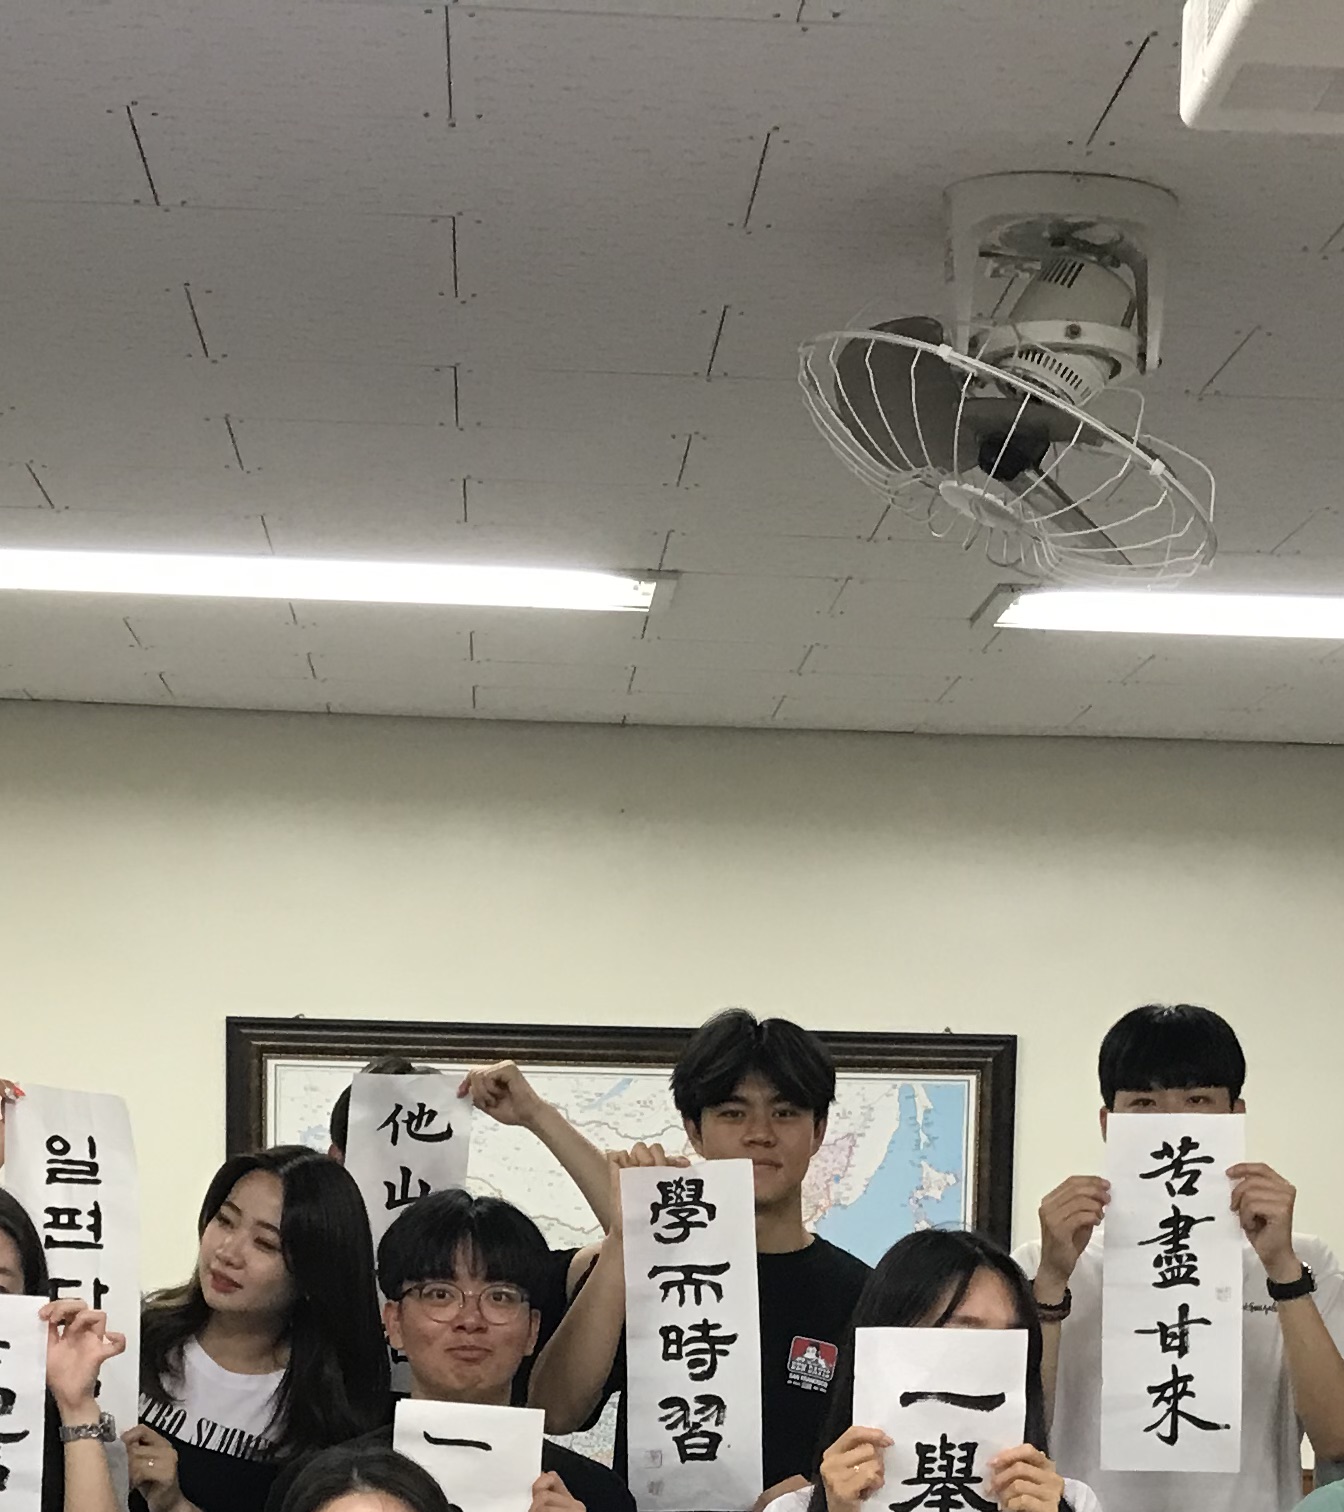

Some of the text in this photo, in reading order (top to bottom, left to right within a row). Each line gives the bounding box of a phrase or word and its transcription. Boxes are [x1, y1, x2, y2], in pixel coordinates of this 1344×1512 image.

[646, 1176, 738, 1465] 學而時習
[1134, 1135, 1231, 1447] 苦盡甘來
